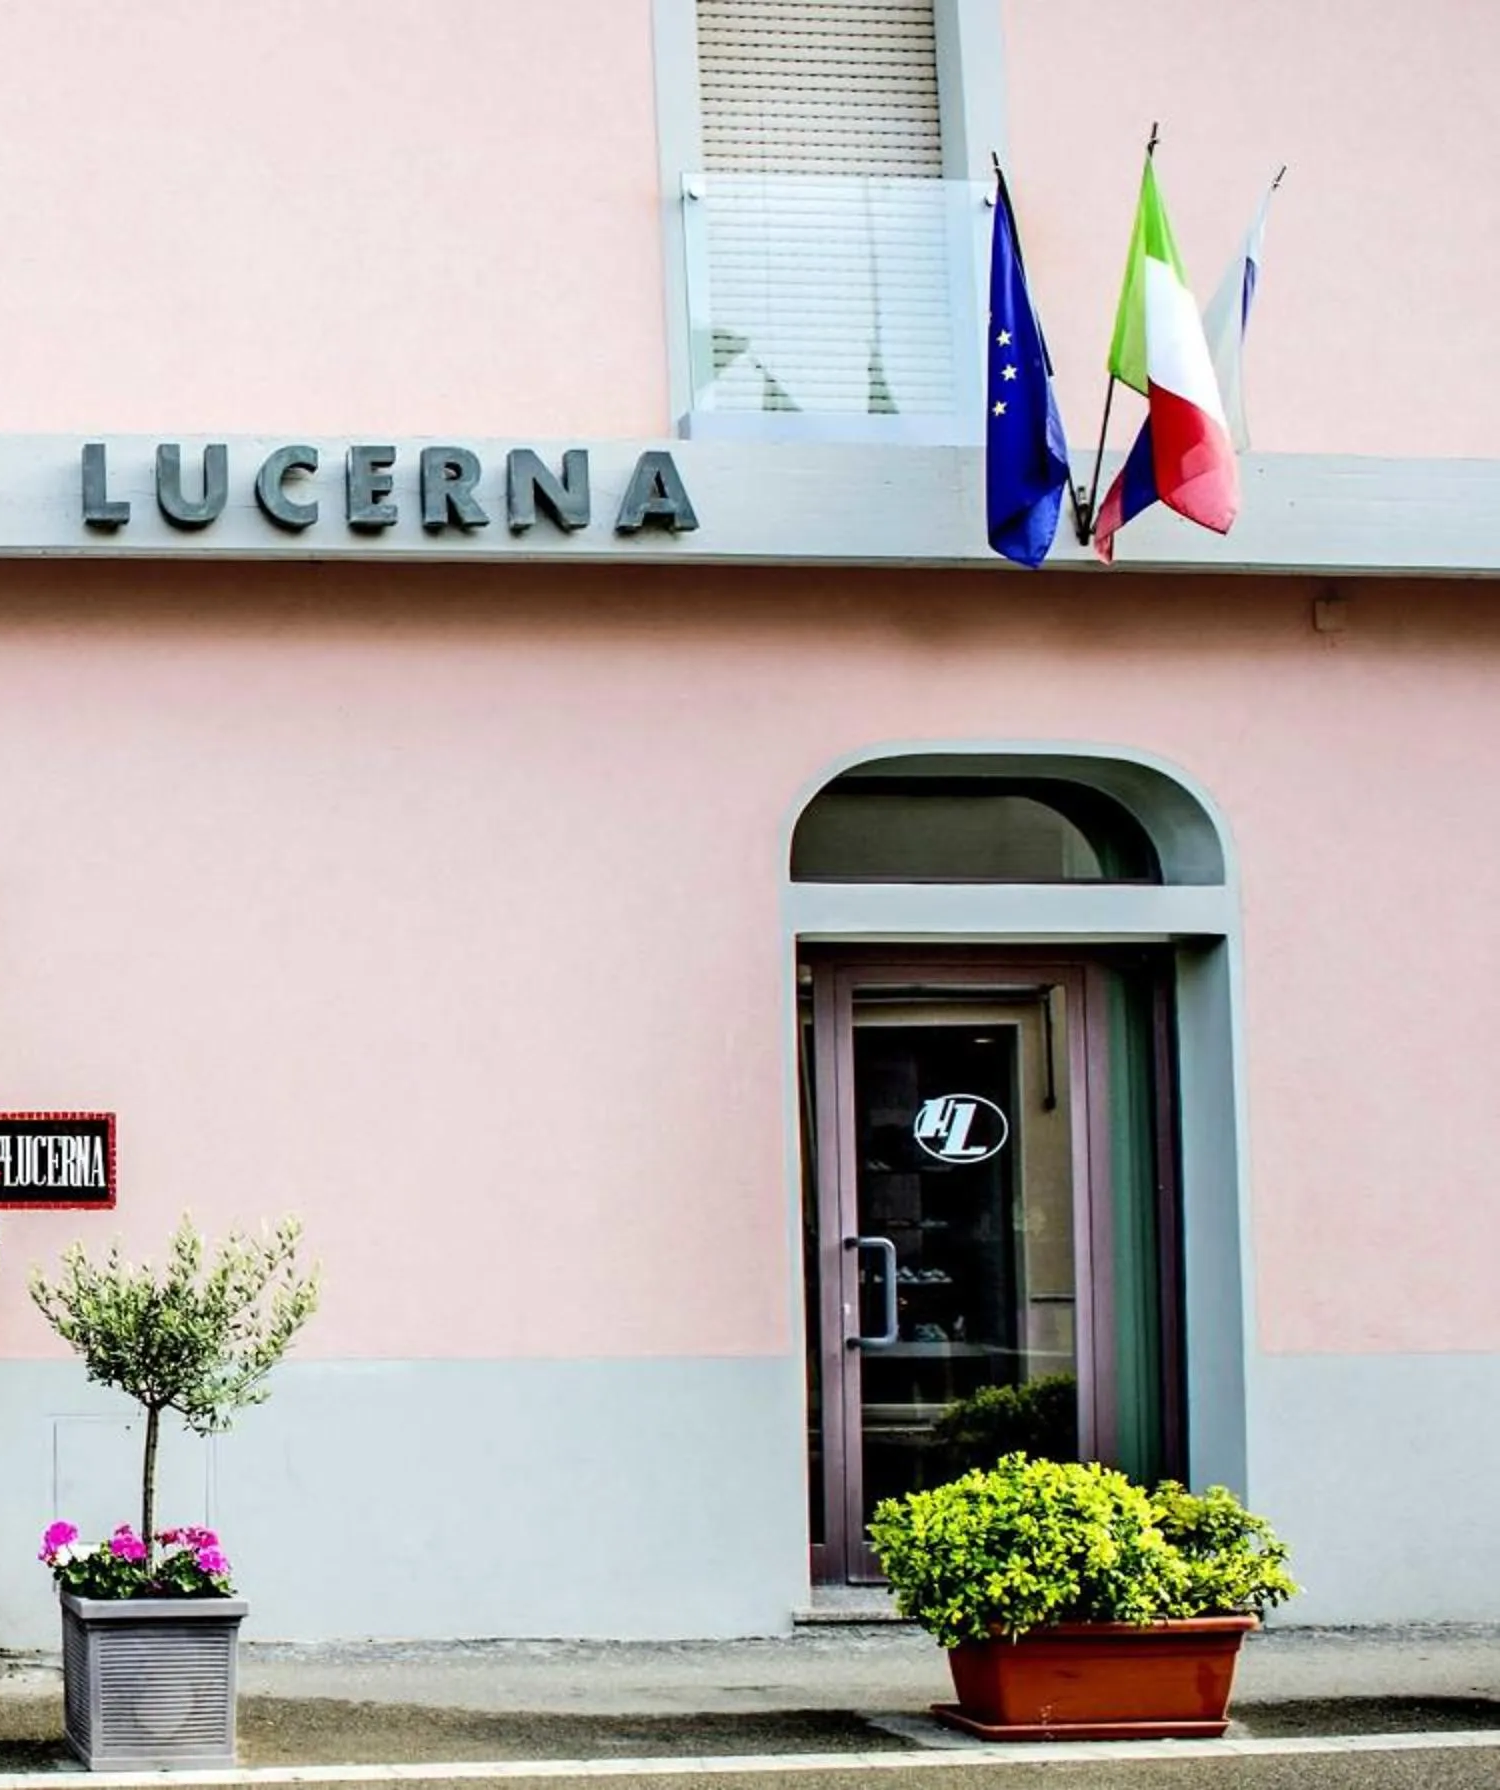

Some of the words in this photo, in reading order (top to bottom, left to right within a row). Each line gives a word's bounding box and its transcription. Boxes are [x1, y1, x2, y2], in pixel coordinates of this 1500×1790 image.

[81, 443, 700, 532] LUCERNA
[913, 1099, 987, 1155] HL
[3, 1135, 106, 1187] LUCERNA
